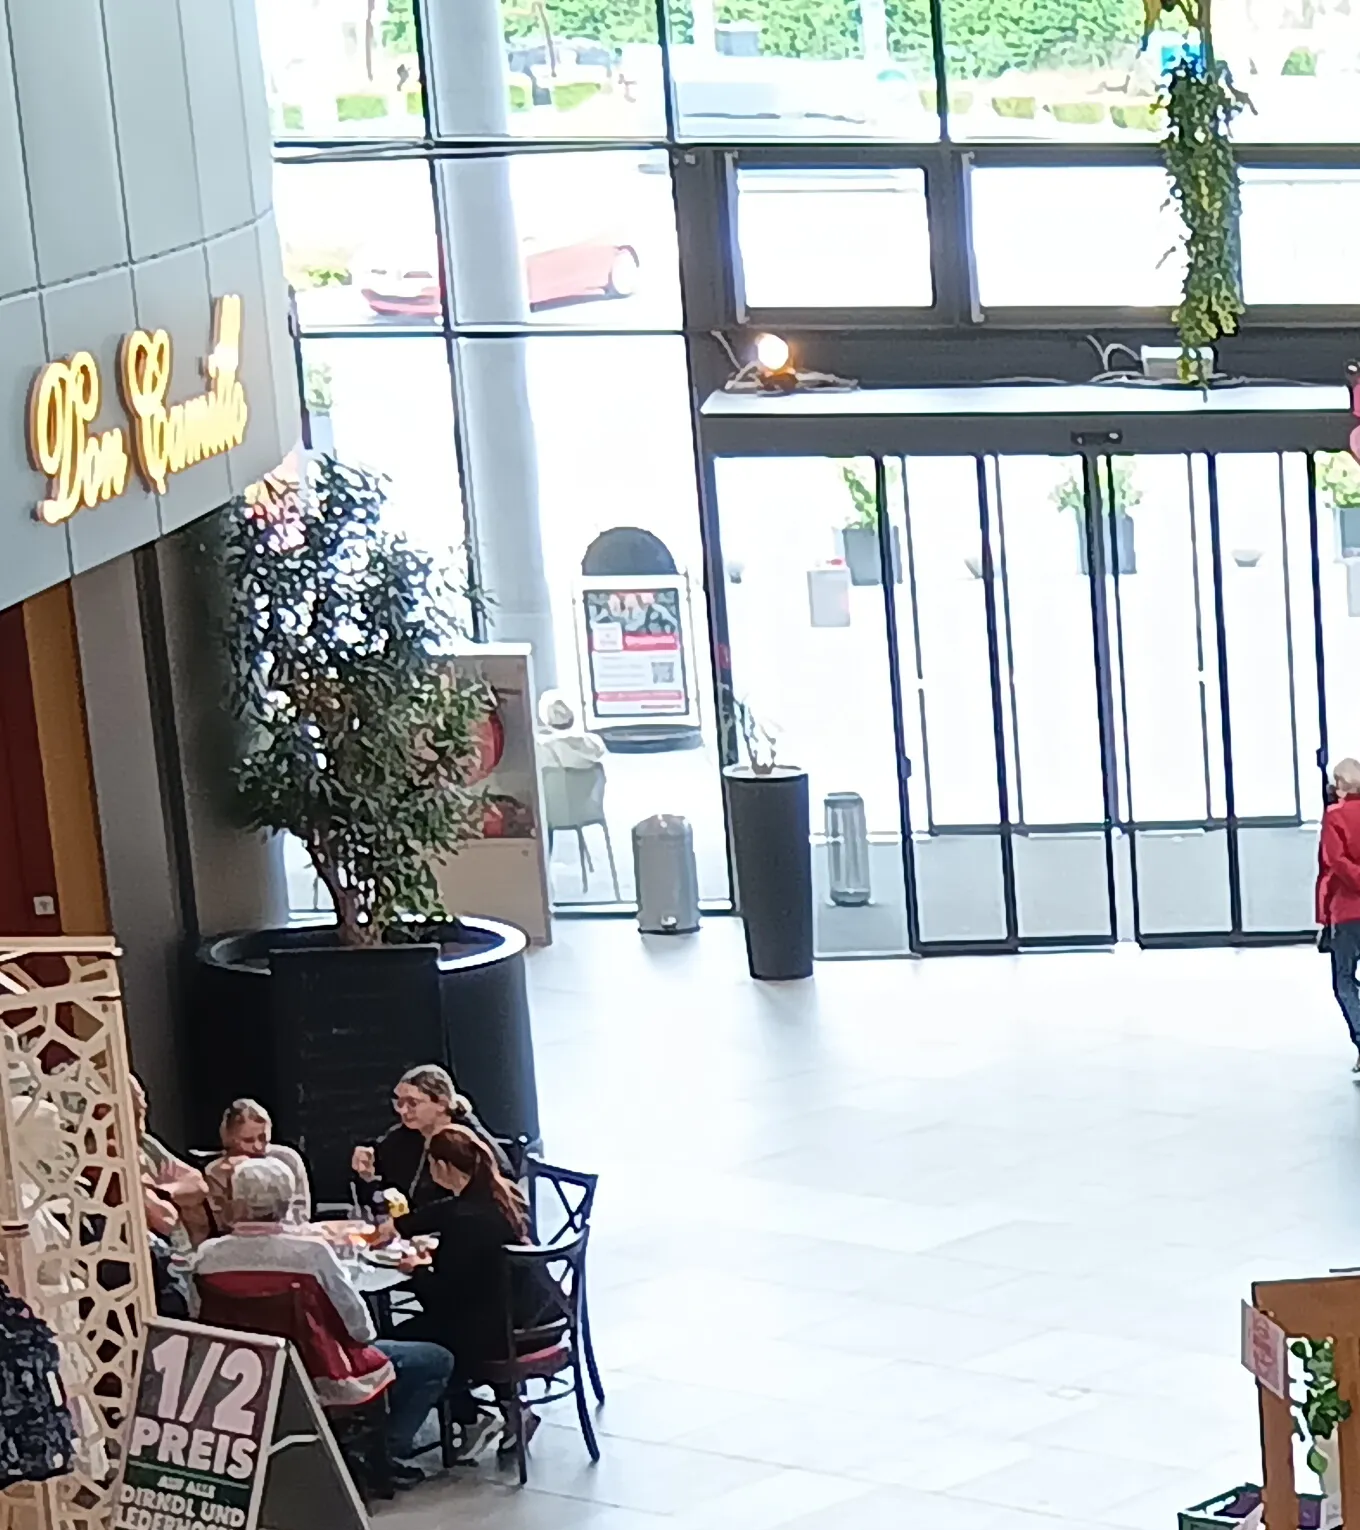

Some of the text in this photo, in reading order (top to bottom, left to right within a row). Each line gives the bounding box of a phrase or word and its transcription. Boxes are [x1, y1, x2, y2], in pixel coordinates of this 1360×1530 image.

[36, 294, 248, 525] Don Camillo
[151, 1333, 263, 1436] 1/2
[128, 1416, 258, 1481] PREIS
[120, 1484, 246, 1528] DIRNDL UND
